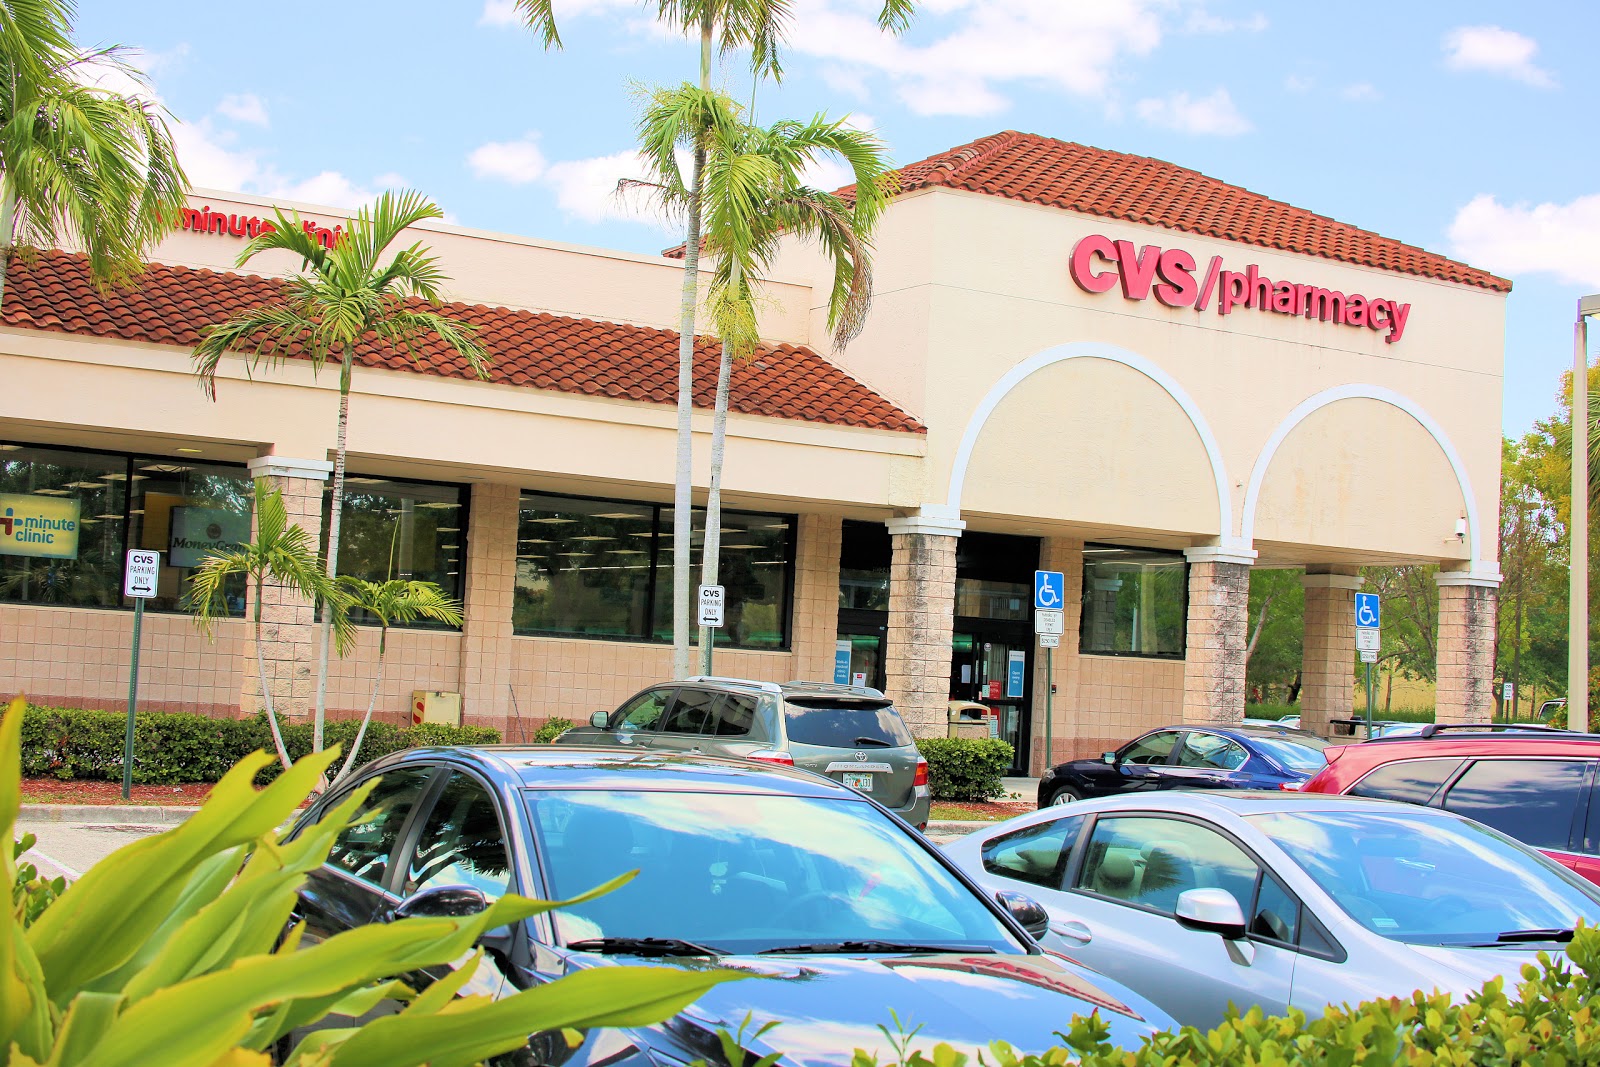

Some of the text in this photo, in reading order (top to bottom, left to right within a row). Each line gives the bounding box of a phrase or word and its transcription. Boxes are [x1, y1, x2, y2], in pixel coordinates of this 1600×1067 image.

[173, 205, 277, 239] minute
[1069, 234, 1411, 344] CVS/pharmacy
[25, 515, 76, 531] minute
[15, 528, 54, 544] clinic
[133, 555, 154, 565] CVS
[130, 565, 155, 575] PARKING
[134, 575, 149, 585] ONLY
[703, 590, 720, 598] CVS
